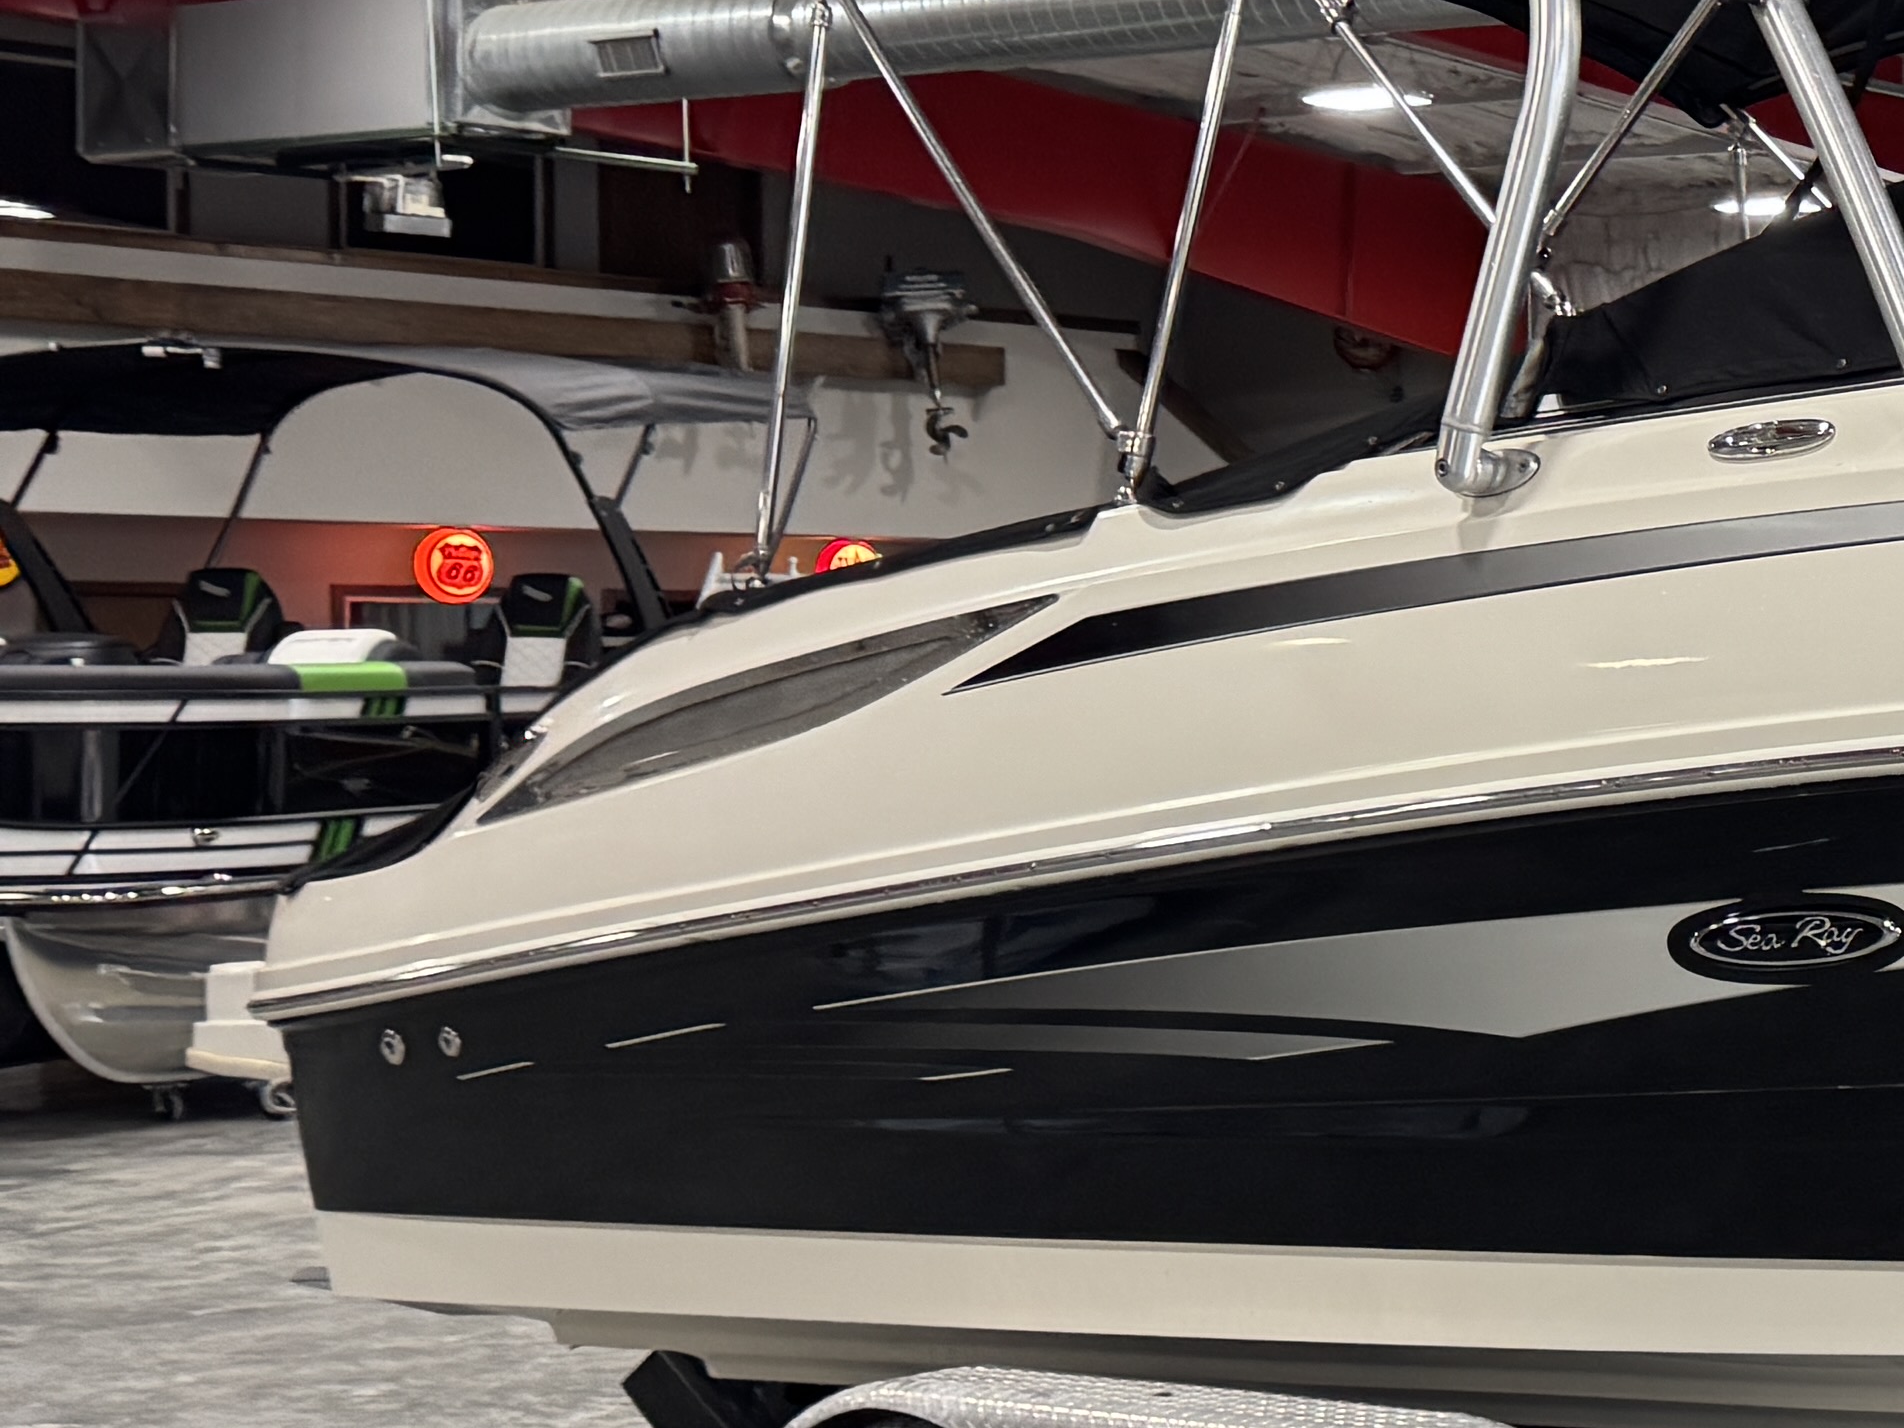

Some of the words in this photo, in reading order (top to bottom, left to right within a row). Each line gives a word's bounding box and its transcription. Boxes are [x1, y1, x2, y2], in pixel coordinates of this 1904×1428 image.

[445, 562, 479, 583] 66
[1716, 924, 1785, 953] Sea
[1791, 916, 1864, 955] Ray
